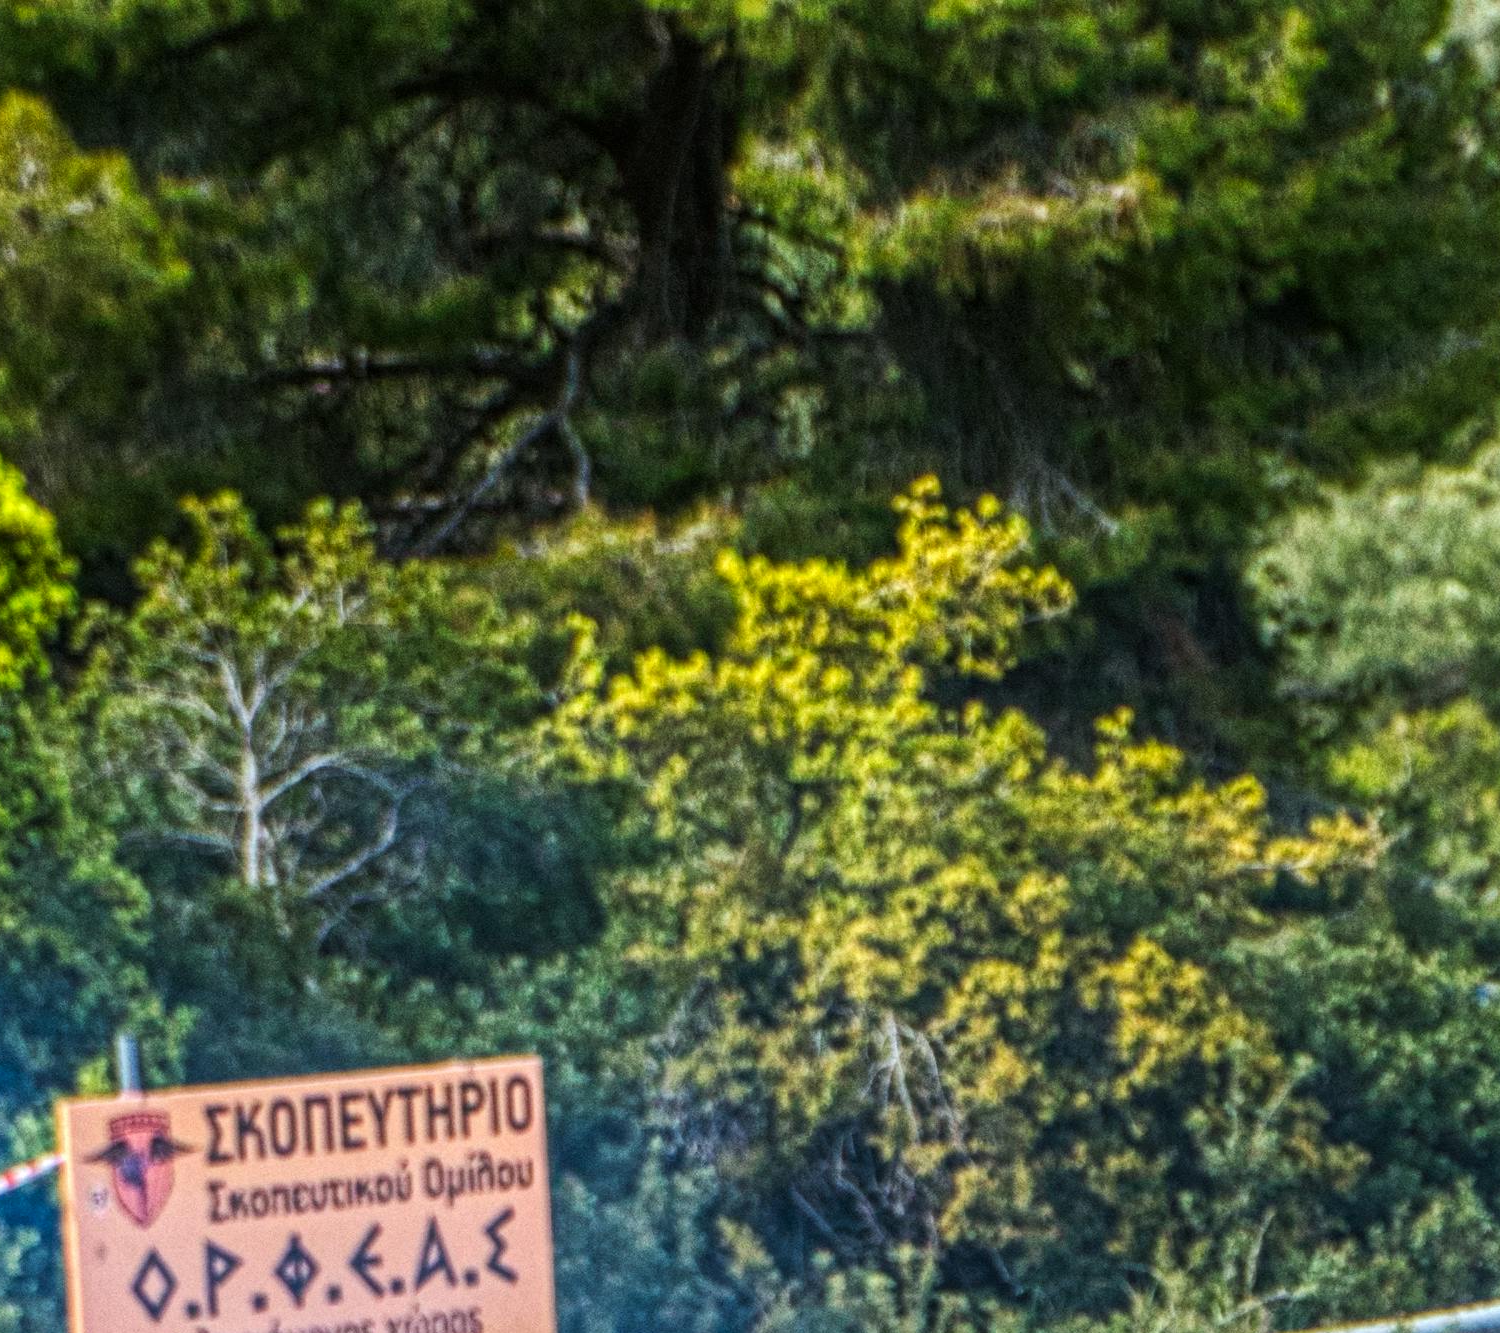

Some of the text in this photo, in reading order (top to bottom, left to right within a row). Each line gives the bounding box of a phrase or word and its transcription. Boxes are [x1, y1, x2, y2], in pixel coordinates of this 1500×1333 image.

[205, 1075, 532, 1165] ΣΚΟΠΕΥΤΗΡΙΟ
[208, 1154, 534, 1225] Σκοπευτικού Ομίλου
